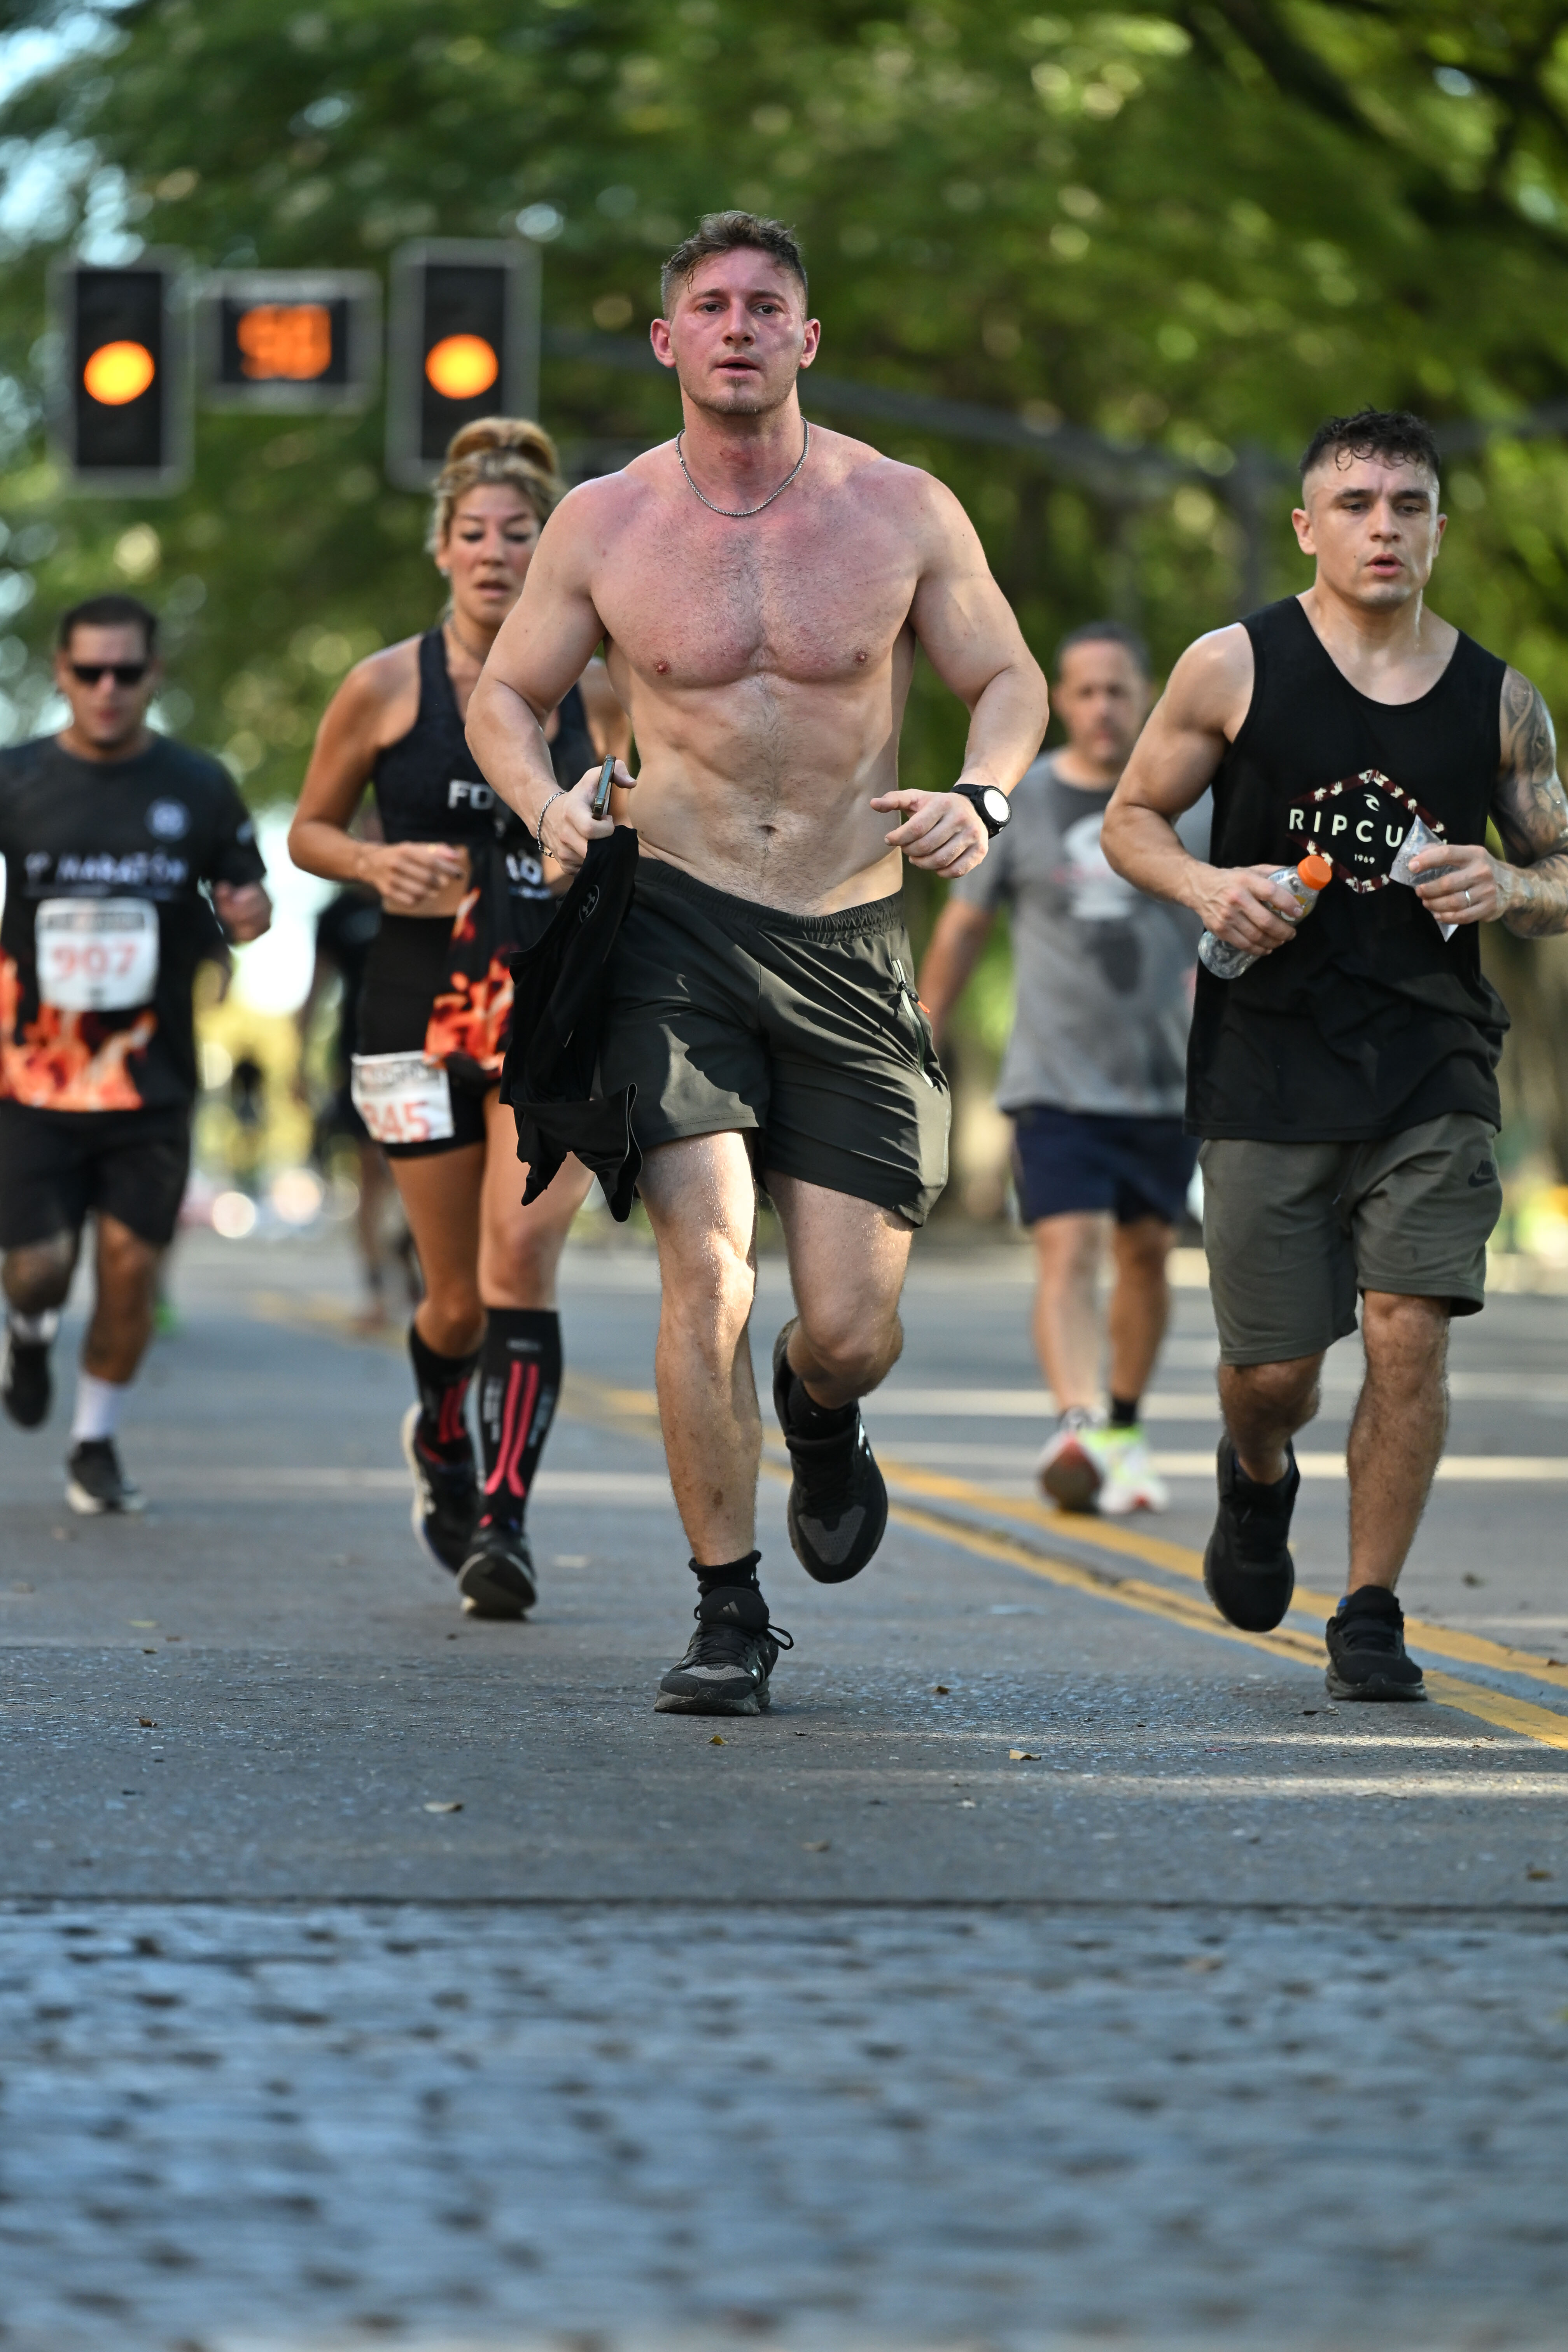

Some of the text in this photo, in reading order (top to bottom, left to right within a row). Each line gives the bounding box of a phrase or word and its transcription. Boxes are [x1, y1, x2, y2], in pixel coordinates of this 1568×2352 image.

[1290, 808, 1447, 848] RIPCU
[1354, 853, 1376, 864] 1969
[51, 943, 137, 982] 907
